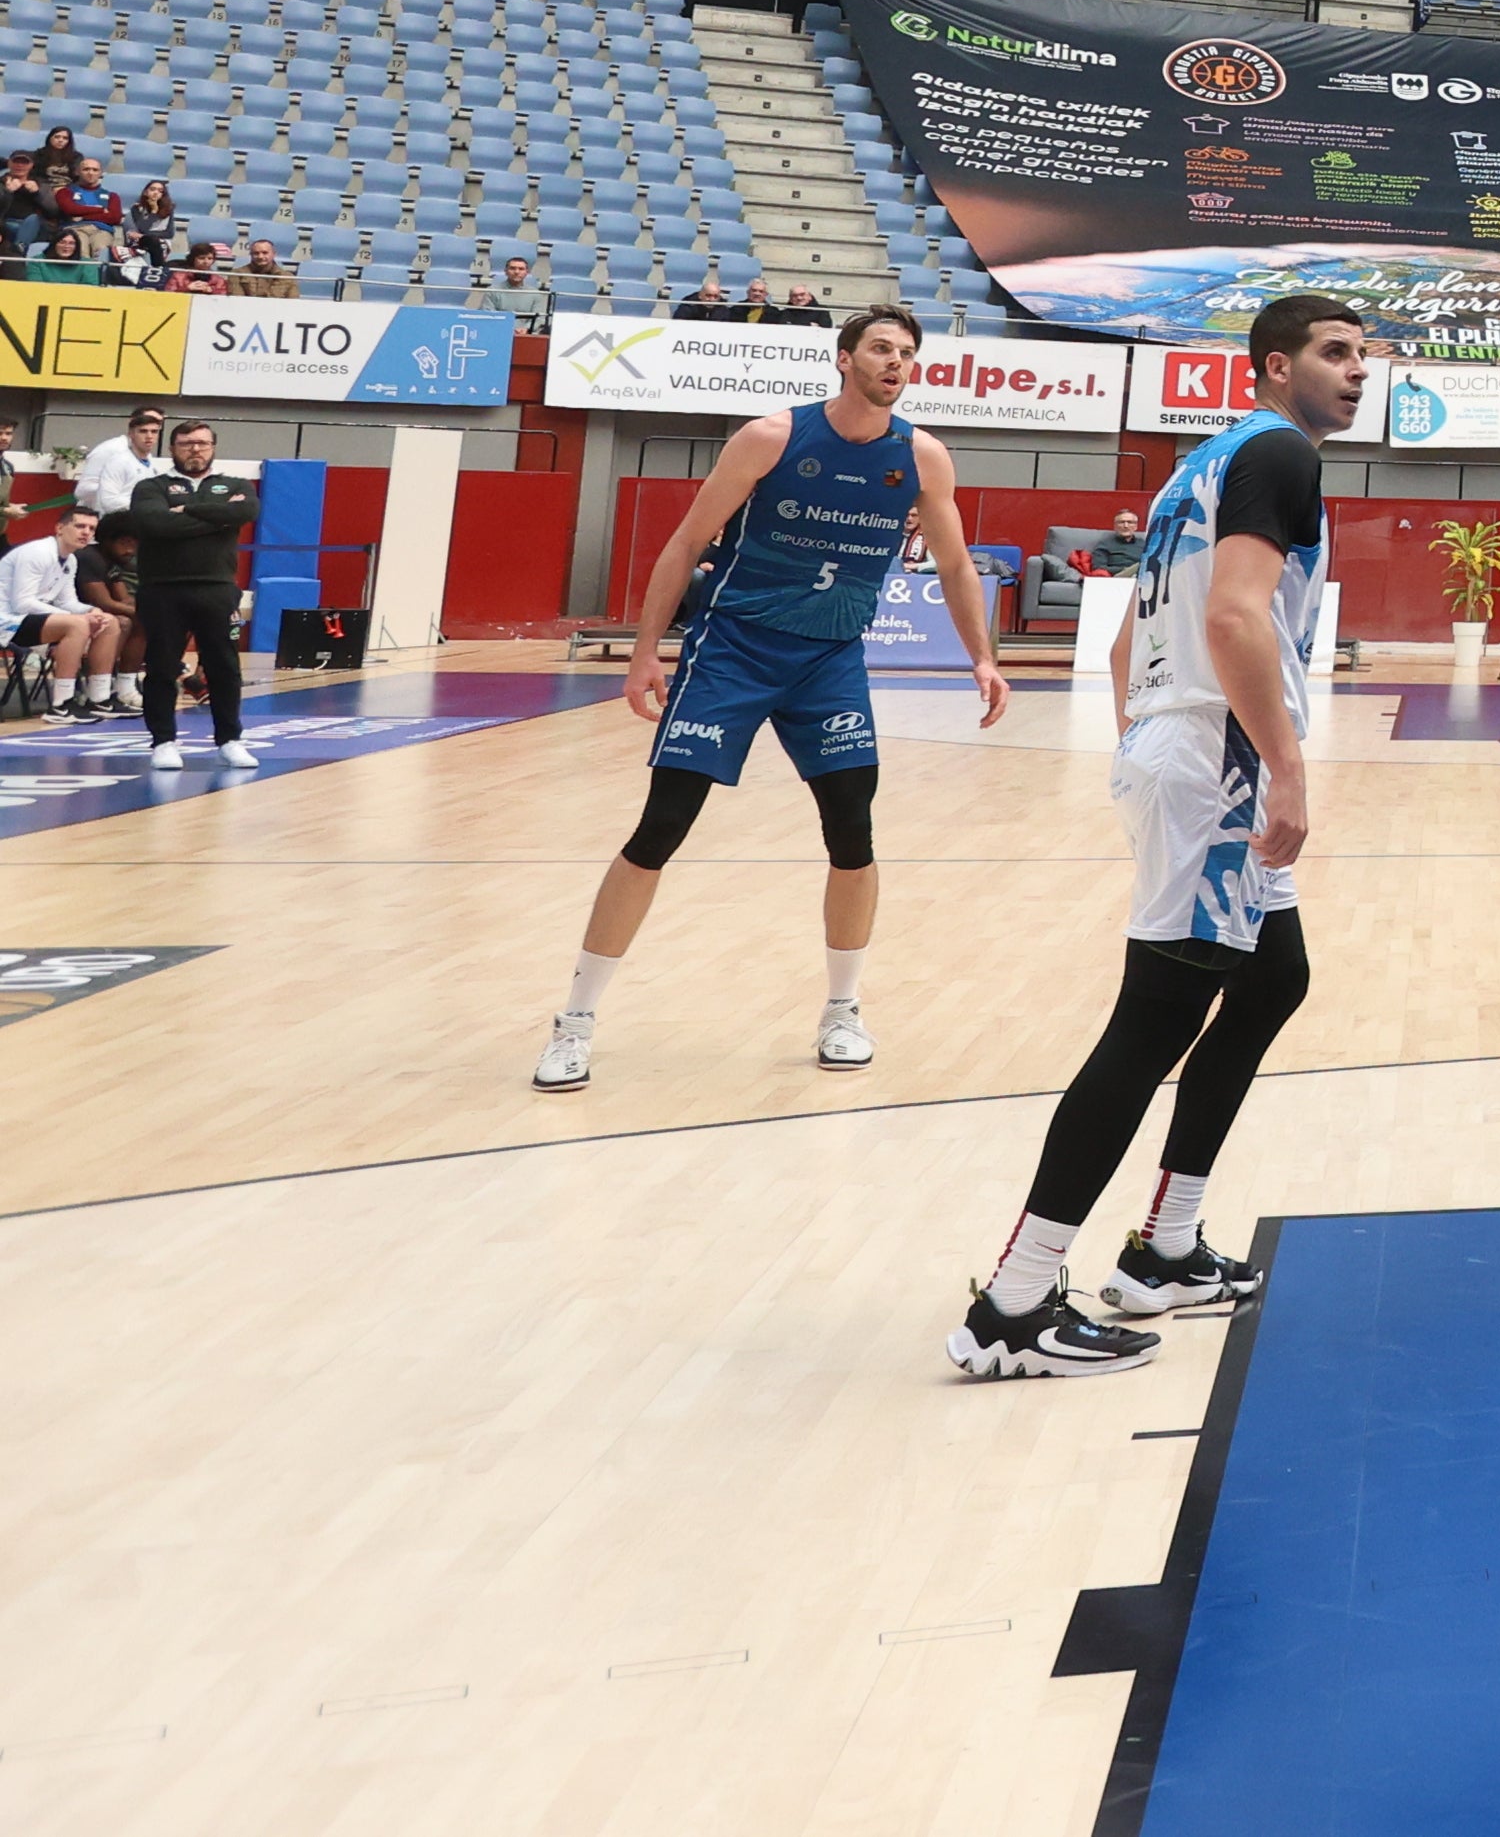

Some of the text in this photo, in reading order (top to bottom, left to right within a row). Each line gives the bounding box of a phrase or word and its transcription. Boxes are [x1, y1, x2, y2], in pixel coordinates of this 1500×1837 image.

[946, 25, 1118, 67] Naturklima
[911, 71, 1152, 119] Aldaketa txikiek
[1193, 87, 1258, 102] BASKET
[913, 85, 1145, 130] eragin handiak
[916, 97, 1128, 138] izan ditzakete
[921, 117, 1121, 155] Los pequeños
[924, 130, 1170, 169] cambios pueden
[938, 143, 1145, 180] tener grandes
[955, 156, 1094, 185] impactos
[212, 319, 352, 357] SALTO
[1428, 327, 1454, 344] EL
[671, 339, 832, 363] ARQUITECTURA
[1400, 343, 1450, 359] Y TU
[743, 363, 753, 374] Y
[590, 384, 662, 400] Arq&Val
[669, 374, 828, 398] VALORACIONES
[901, 400, 1066, 422] CARPINTERIA METALICA
[1398, 395, 1431, 408] 943
[1159, 413, 1235, 426] SERVICIOS
[1398, 408, 1432, 421] 444
[1399, 421, 1431, 434] 660
[805, 505, 899, 530] Naturklima
[770, 531, 891, 557] GIPUZKOA KIROLAK
[812, 561, 840, 591] 5
[821, 730, 872, 746] HYUNDAI
